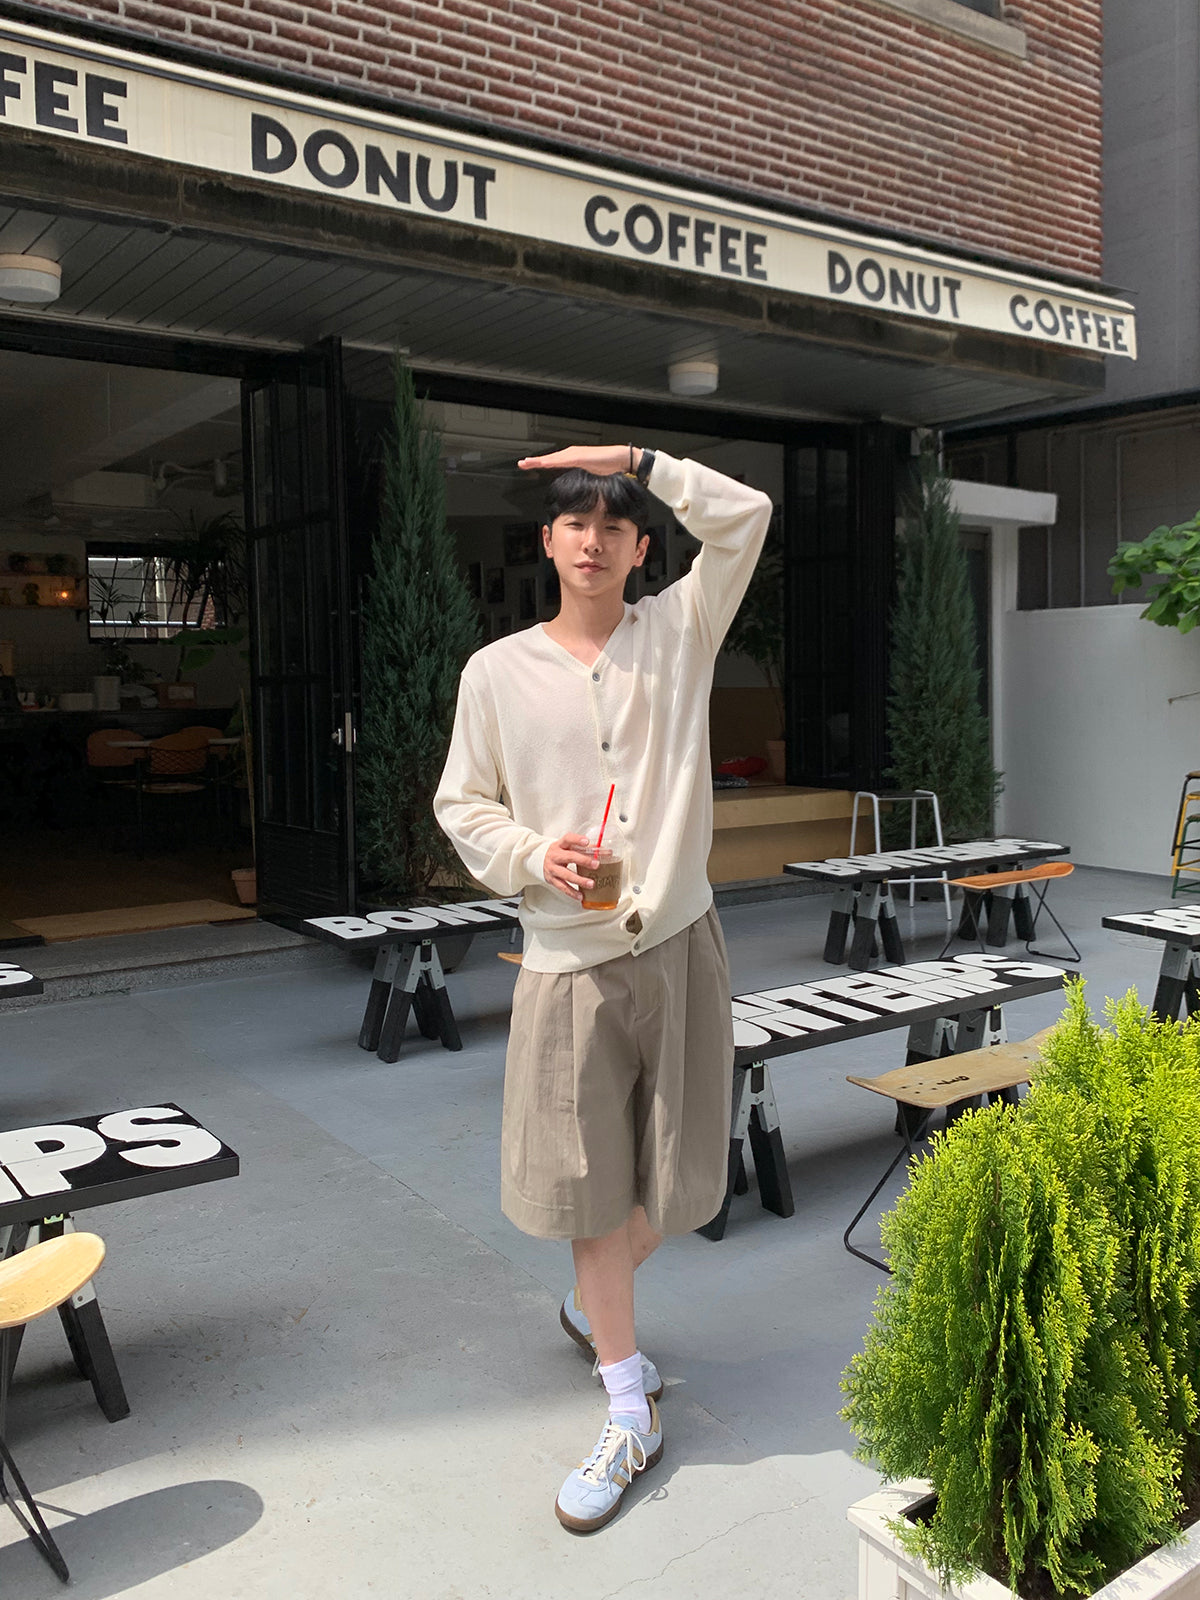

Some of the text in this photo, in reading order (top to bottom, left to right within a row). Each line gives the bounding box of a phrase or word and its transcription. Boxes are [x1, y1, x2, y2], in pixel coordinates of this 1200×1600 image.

[252, 113, 497, 220] DONUT
[585, 195, 768, 281] COFFEE
[828, 250, 962, 318] DONUT
[1009, 294, 1128, 352] COFFEE
[784, 838, 1064, 876] BONTEMPS
